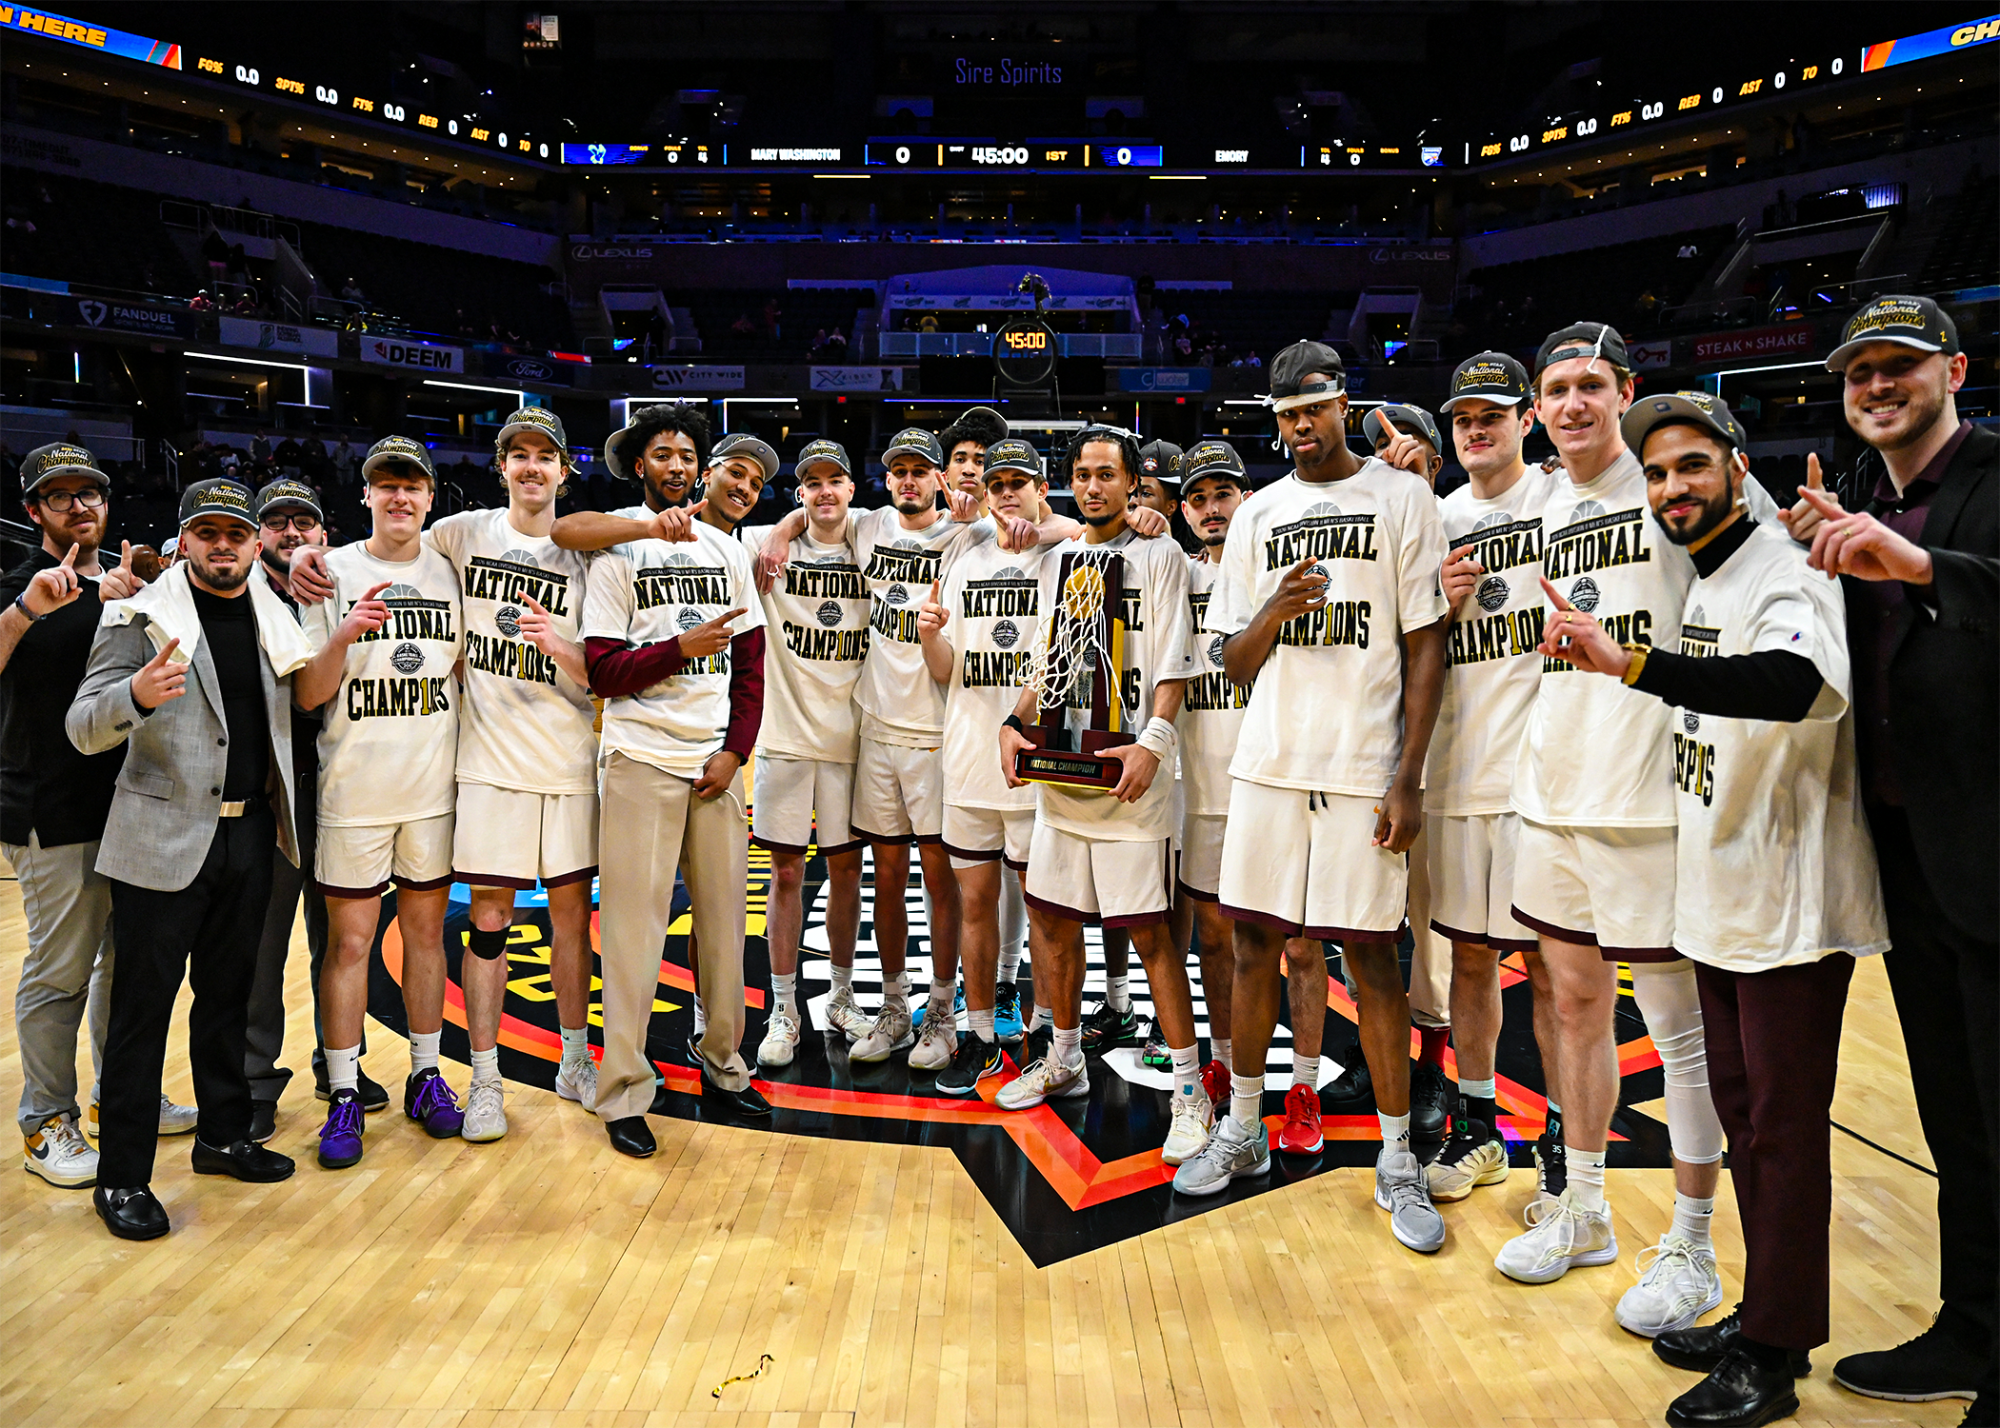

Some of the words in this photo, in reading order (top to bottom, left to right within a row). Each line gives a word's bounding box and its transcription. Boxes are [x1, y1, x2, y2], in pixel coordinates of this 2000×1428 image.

[19, 11, 107, 47] HERE
[1951, 19, 2000, 46] CH
[956, 58, 993, 83] Sire
[1001, 58, 1062, 86] Spirits
[197, 58, 224, 75] FG%
[235, 65, 260, 85] 0.0
[315, 85, 338, 105] 0.0
[352, 96, 375, 113] FT%
[383, 103, 404, 122] 0.0
[418, 113, 438, 129] REB
[448, 119, 458, 135] 0
[470, 126, 489, 142] AST
[498, 132, 508, 148] 0
[519, 139, 531, 151] TO
[539, 143, 549, 158] 0
[1480, 142, 1502, 157] FG%
[1510, 134, 1529, 153] 0.0
[1576, 118, 1597, 136] 0.0
[1611, 111, 1632, 127] FT%
[1641, 102, 1664, 121] 0.0
[1678, 94, 1701, 111] REB
[1712, 87, 1723, 104] 0
[1739, 78, 1762, 96] AST
[1774, 71, 1785, 90] 0
[1802, 65, 1818, 81] TO
[1831, 57, 1843, 76] 0
[668, 151, 678, 163] 0
[698, 151, 708, 163] 4
[751, 148, 777, 161] MARY
[779, 148, 841, 161] WASHINGTON
[896, 147, 910, 164] 0
[972, 147, 1029, 164] 45:00
[1117, 147, 1131, 165] 0
[1215, 150, 1249, 162] EMORY
[1320, 153, 1331, 165] 4
[1350, 153, 1360, 165] 0
[594, 248, 653, 258] LEXUS
[1391, 251, 1451, 261] LEXUS
[113, 306, 176, 325] FANDUEL
[1864, 304, 1921, 320] National
[1005, 332, 1046, 349] 45:00
[1696, 340, 1742, 356] STEAK
[1756, 332, 1807, 349] SHAKE
[390, 345, 452, 369] DEEM
[515, 362, 543, 379] Ford
[1468, 366, 1506, 377] National
[51, 448, 88, 461] National
[1194, 447, 1225, 459] National
[208, 486, 248, 501] National
[278, 483, 310, 496] National
[1339, 515, 1369, 523] BASKETBALL
[1265, 525, 1378, 572] NATIONAL
[464, 566, 568, 618] NATIONAL
[633, 576, 732, 610] NATIONAL
[785, 569, 871, 600] NATIONAL
[962, 588, 1039, 619] NATIONA
[1030, 759, 1057, 770] NATIONAL
[1058, 761, 1096, 774] CHAMPION
